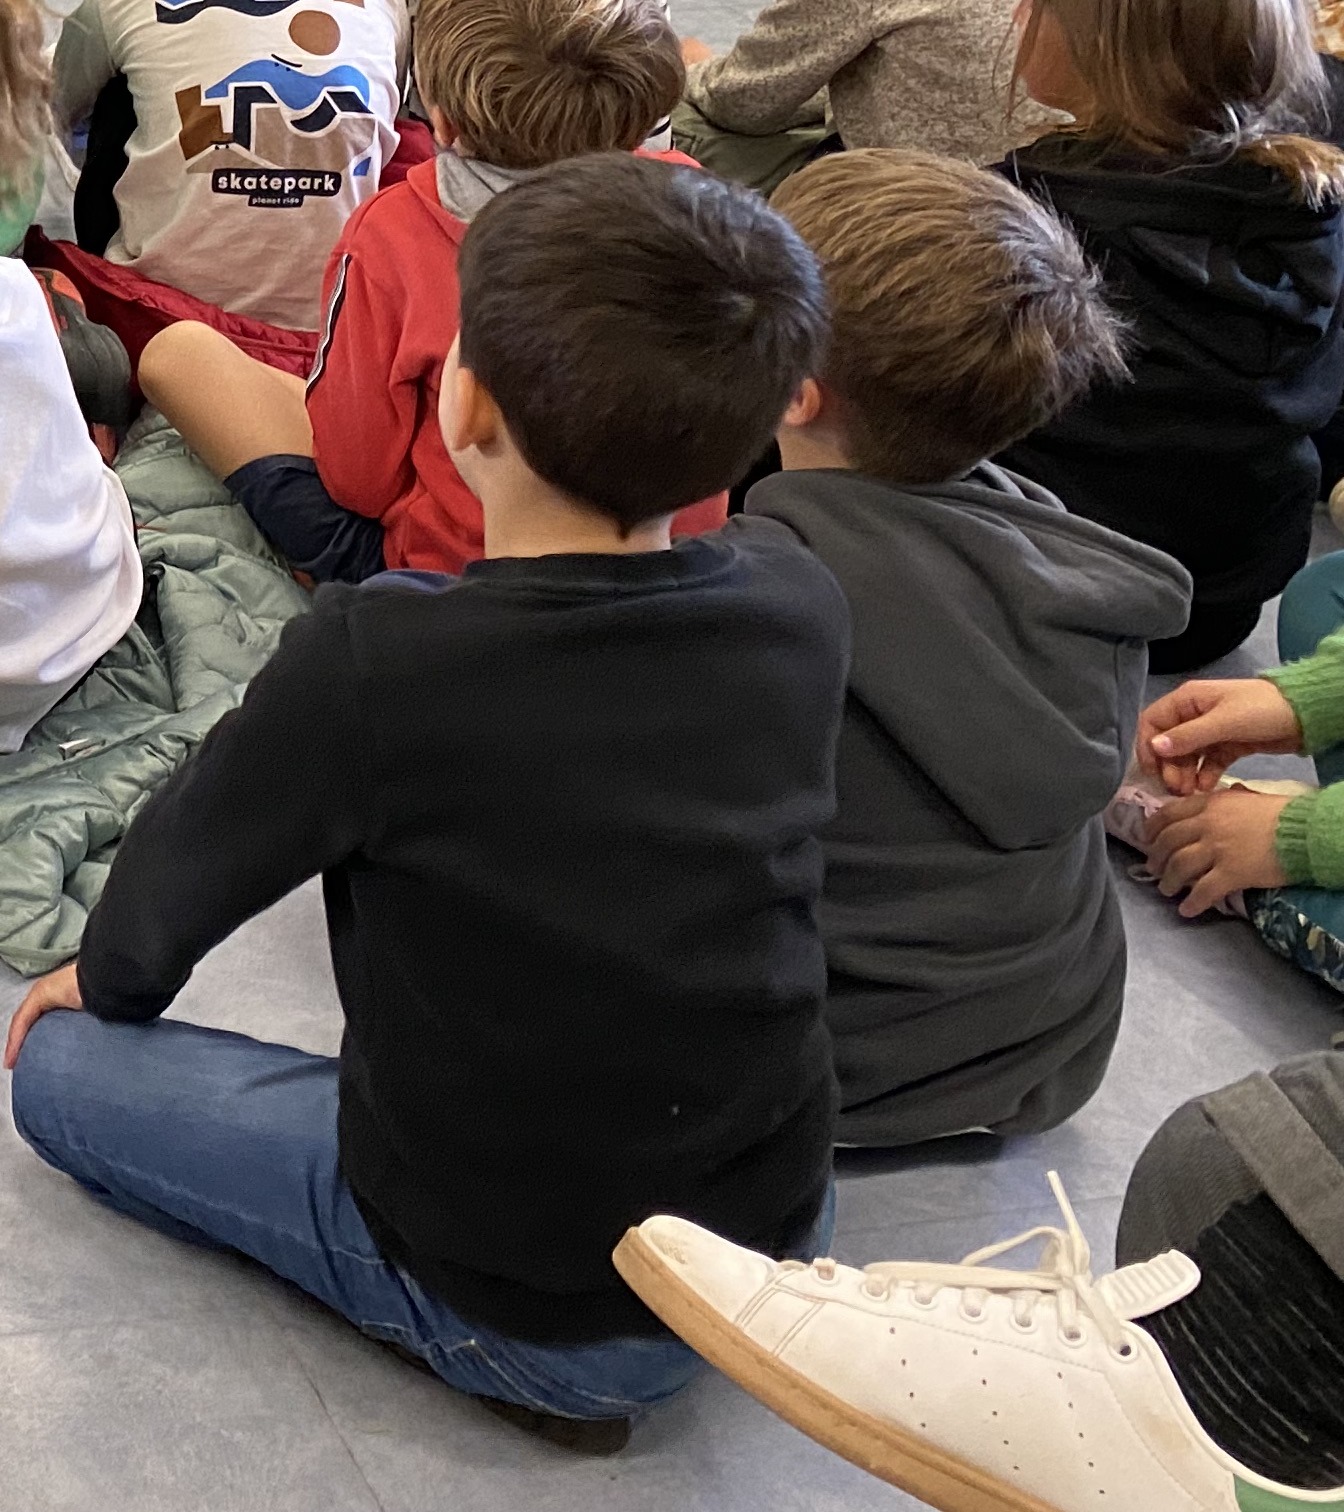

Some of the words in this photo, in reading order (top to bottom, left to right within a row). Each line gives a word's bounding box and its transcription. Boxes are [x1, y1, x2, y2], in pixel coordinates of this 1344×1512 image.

[218, 172, 335, 194] skatepark
[252, 196, 281, 204] planet
[282, 196, 300, 204] ride
